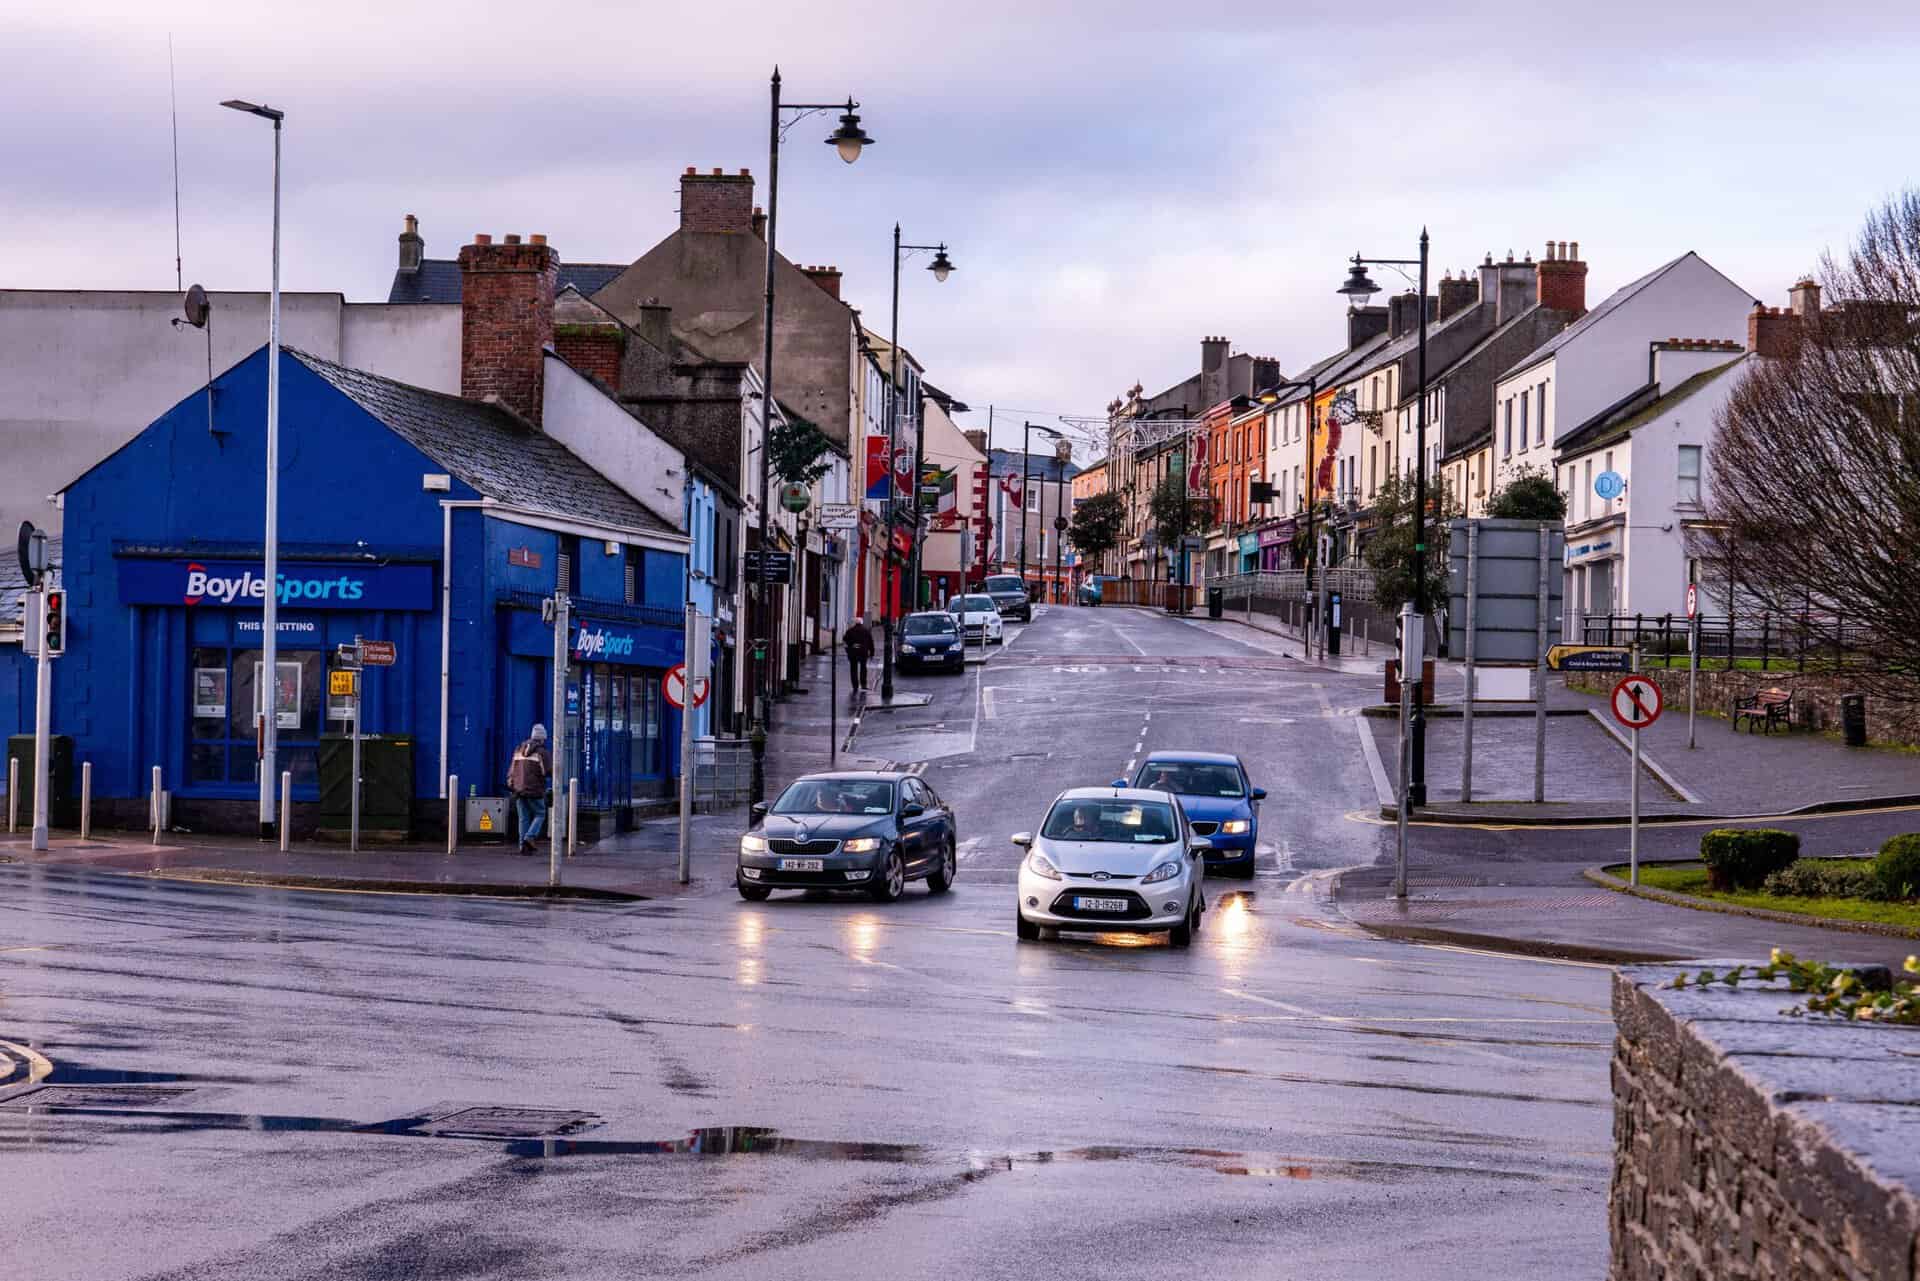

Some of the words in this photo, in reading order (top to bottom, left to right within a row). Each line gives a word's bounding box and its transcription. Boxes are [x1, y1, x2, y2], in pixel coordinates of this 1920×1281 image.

[187, 571, 363, 604] BoyleSports
[238, 622, 260, 631] THIS
[577, 627, 634, 658] BoyleSports
